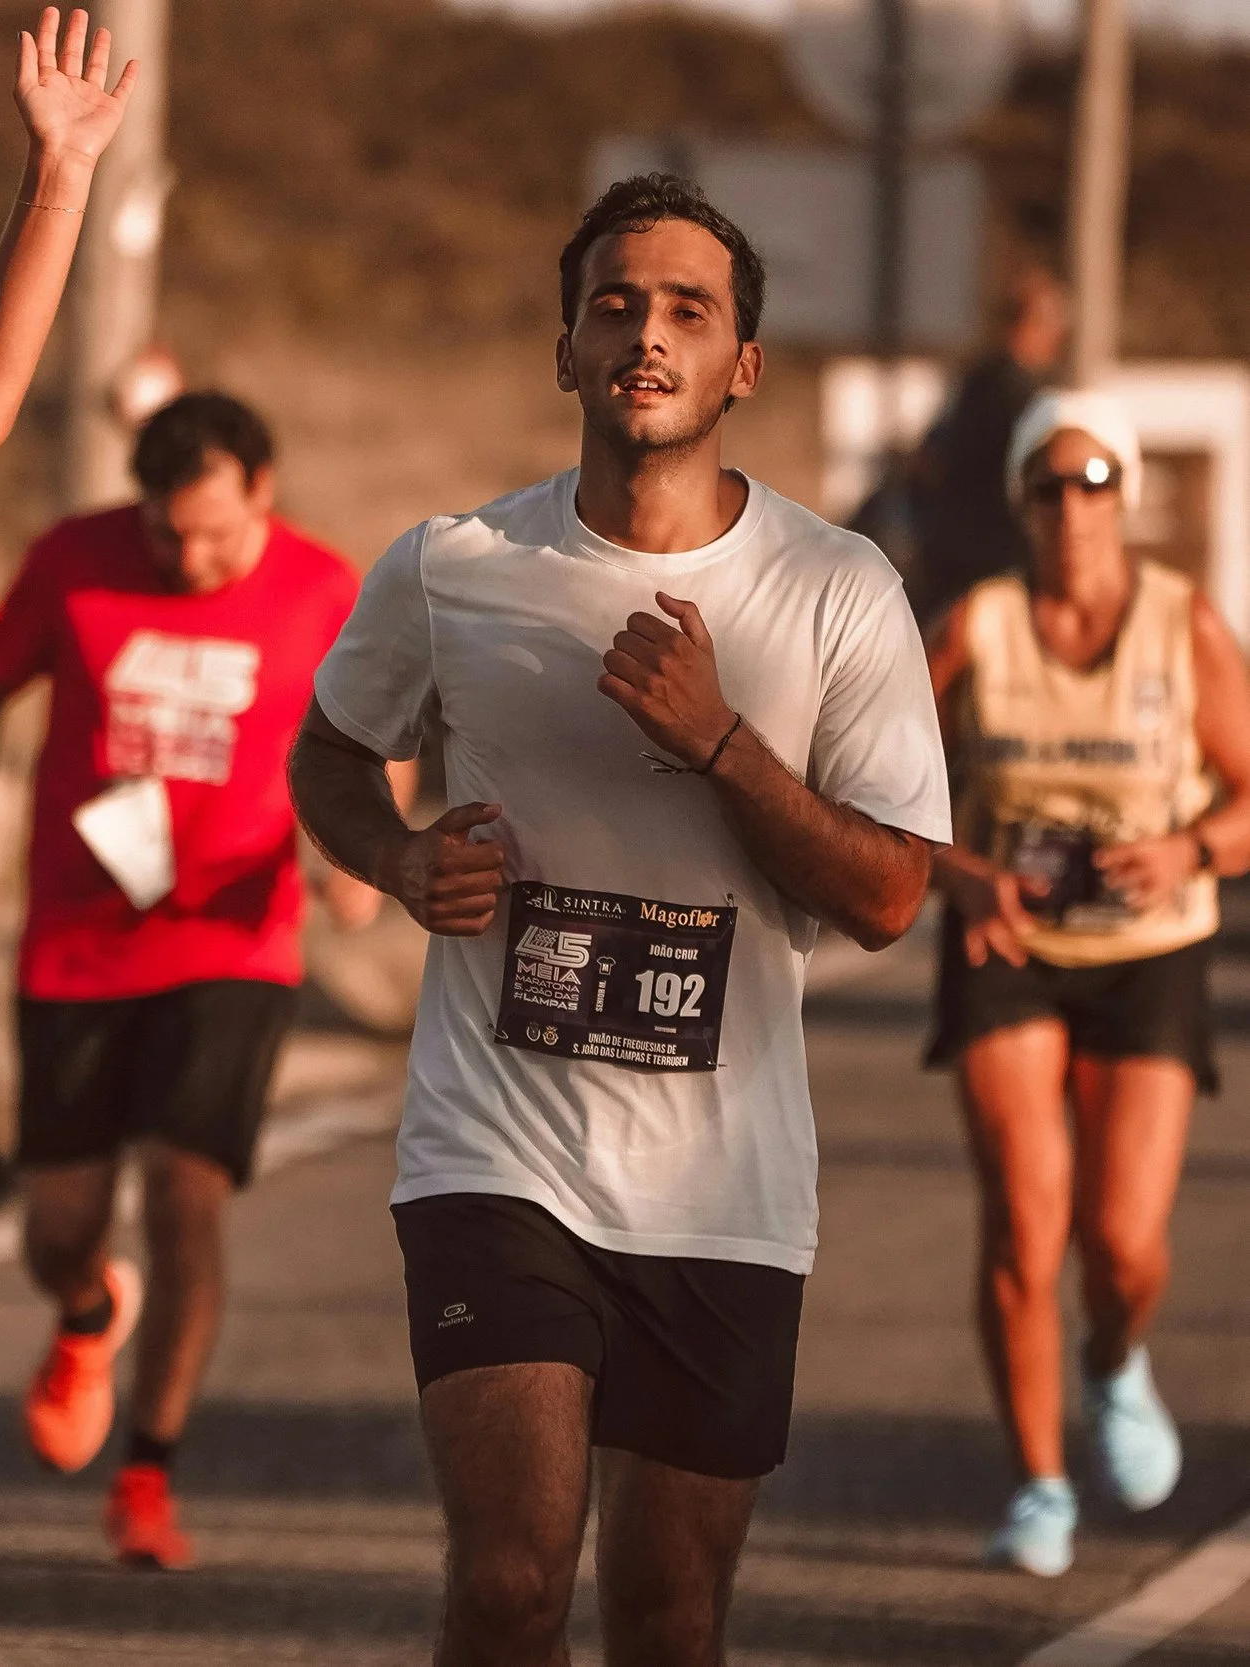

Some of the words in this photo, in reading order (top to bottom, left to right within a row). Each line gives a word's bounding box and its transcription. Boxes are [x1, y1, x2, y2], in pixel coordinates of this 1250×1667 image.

[563, 897, 622, 914] SINTRA
[639, 902, 720, 929] Magoflor
[514, 924, 592, 969] 45
[649, 943, 673, 959] JOÃO
[674, 948, 699, 961] CRUZ
[517, 958, 582, 985] MEIA
[515, 974, 580, 993] MARATONA
[635, 969, 705, 1018] 192
[513, 991, 578, 1011] #LAMPAS
[554, 991, 579, 1002] DAS
[572, 1043, 580, 1054] S.
[581, 1044, 599, 1056] JOÃO
[599, 1047, 615, 1058] DAS
[616, 1049, 645, 1063] LAMPAS
[646, 1053, 652, 1064] E
[652, 1054, 689, 1067] TERRUGEM
[588, 1032, 611, 1045] UNIÃO
[611, 1036, 622, 1047] DE
[622, 1038, 666, 1055] FREGUESIAS
[667, 1044, 677, 1055] DE
